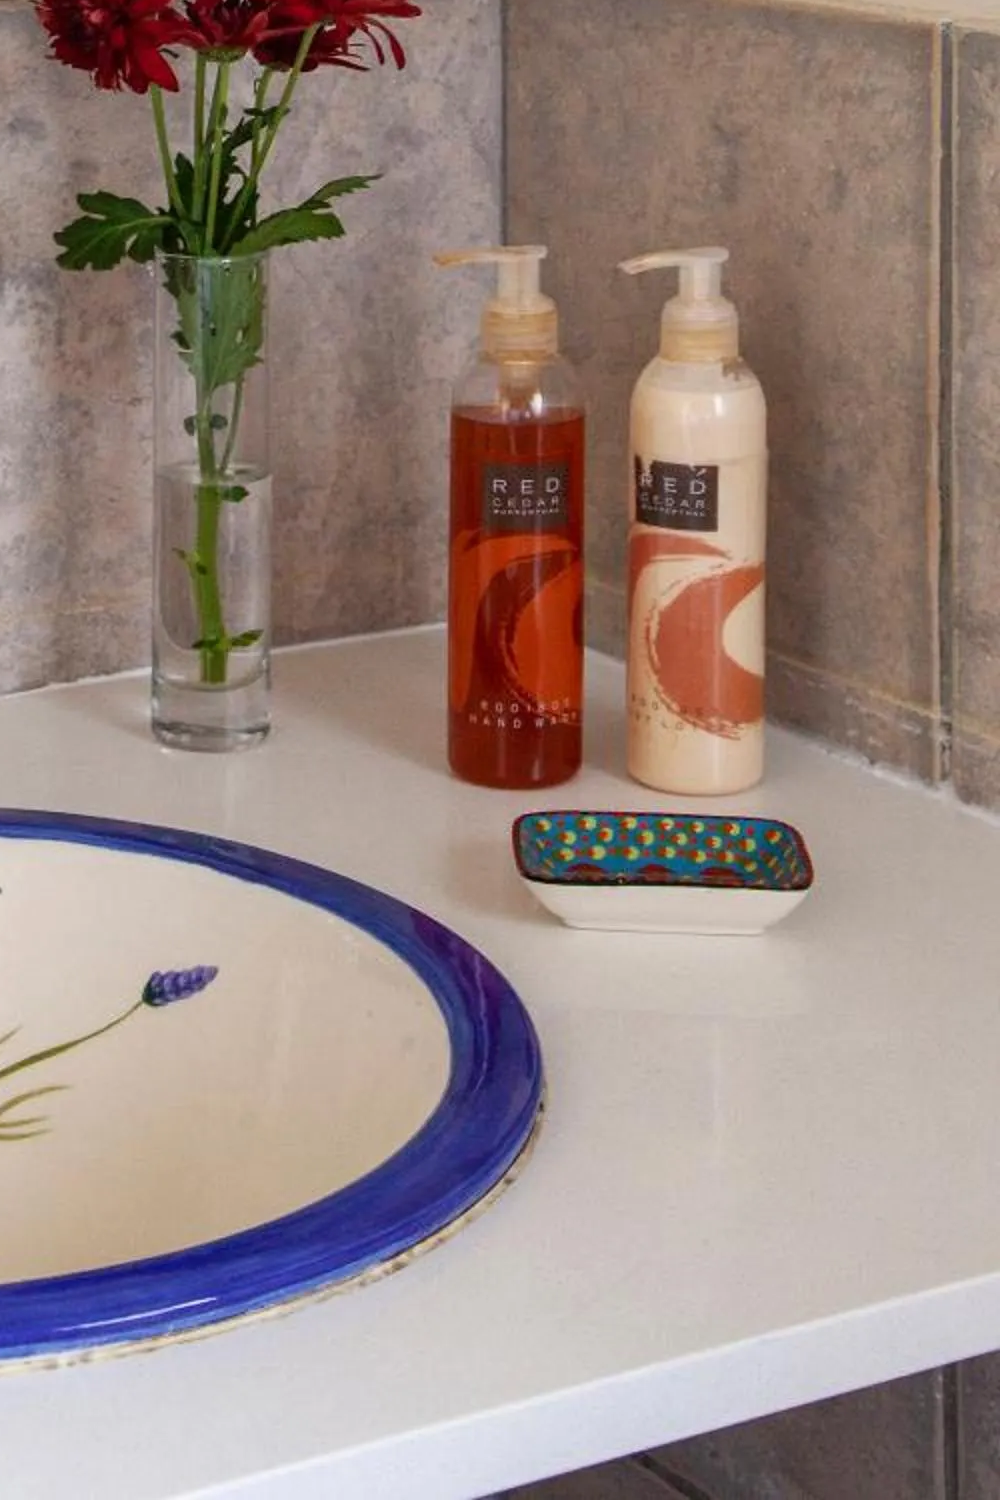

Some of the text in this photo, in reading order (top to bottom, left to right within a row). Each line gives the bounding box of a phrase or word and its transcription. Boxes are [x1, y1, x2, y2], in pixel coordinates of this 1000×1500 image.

[492, 477, 559, 494] RED
[641, 472, 705, 495] RED
[492, 495, 559, 508] CEDAR
[468, 713, 522, 729] HAND
